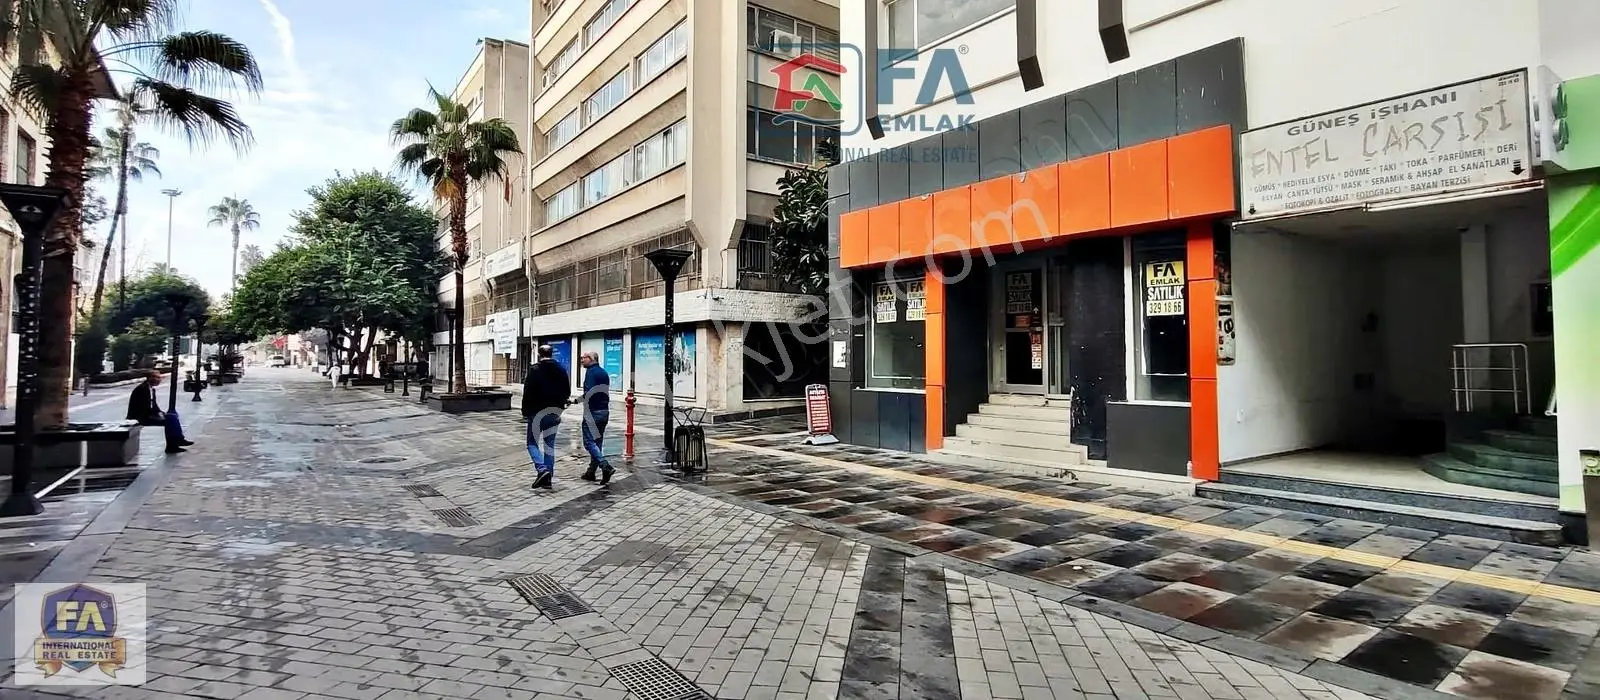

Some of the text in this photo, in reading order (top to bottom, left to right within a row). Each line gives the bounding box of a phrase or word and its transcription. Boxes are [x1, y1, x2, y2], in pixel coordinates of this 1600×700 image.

[1287, 113, 1360, 136] GÜNEŞ
[1251, 136, 1339, 178] ENTEL
[1341, 180, 1362, 190] MASK
[1407, 172, 1413, 180] &
[1449, 165, 1458, 174] EL
[1461, 158, 1509, 172] SANATLARI
[1343, 167, 1370, 178] DÖVME
[1380, 163, 1397, 172] TAKI
[1407, 157, 1428, 168] TOKA
[1410, 180, 1438, 192] BAYAN
[1153, 263, 1176, 278] FA
[1150, 277, 1180, 286] EMLAK
[1147, 285, 1184, 301] SATILIK
[1149, 301, 1182, 313] 329 18 66
